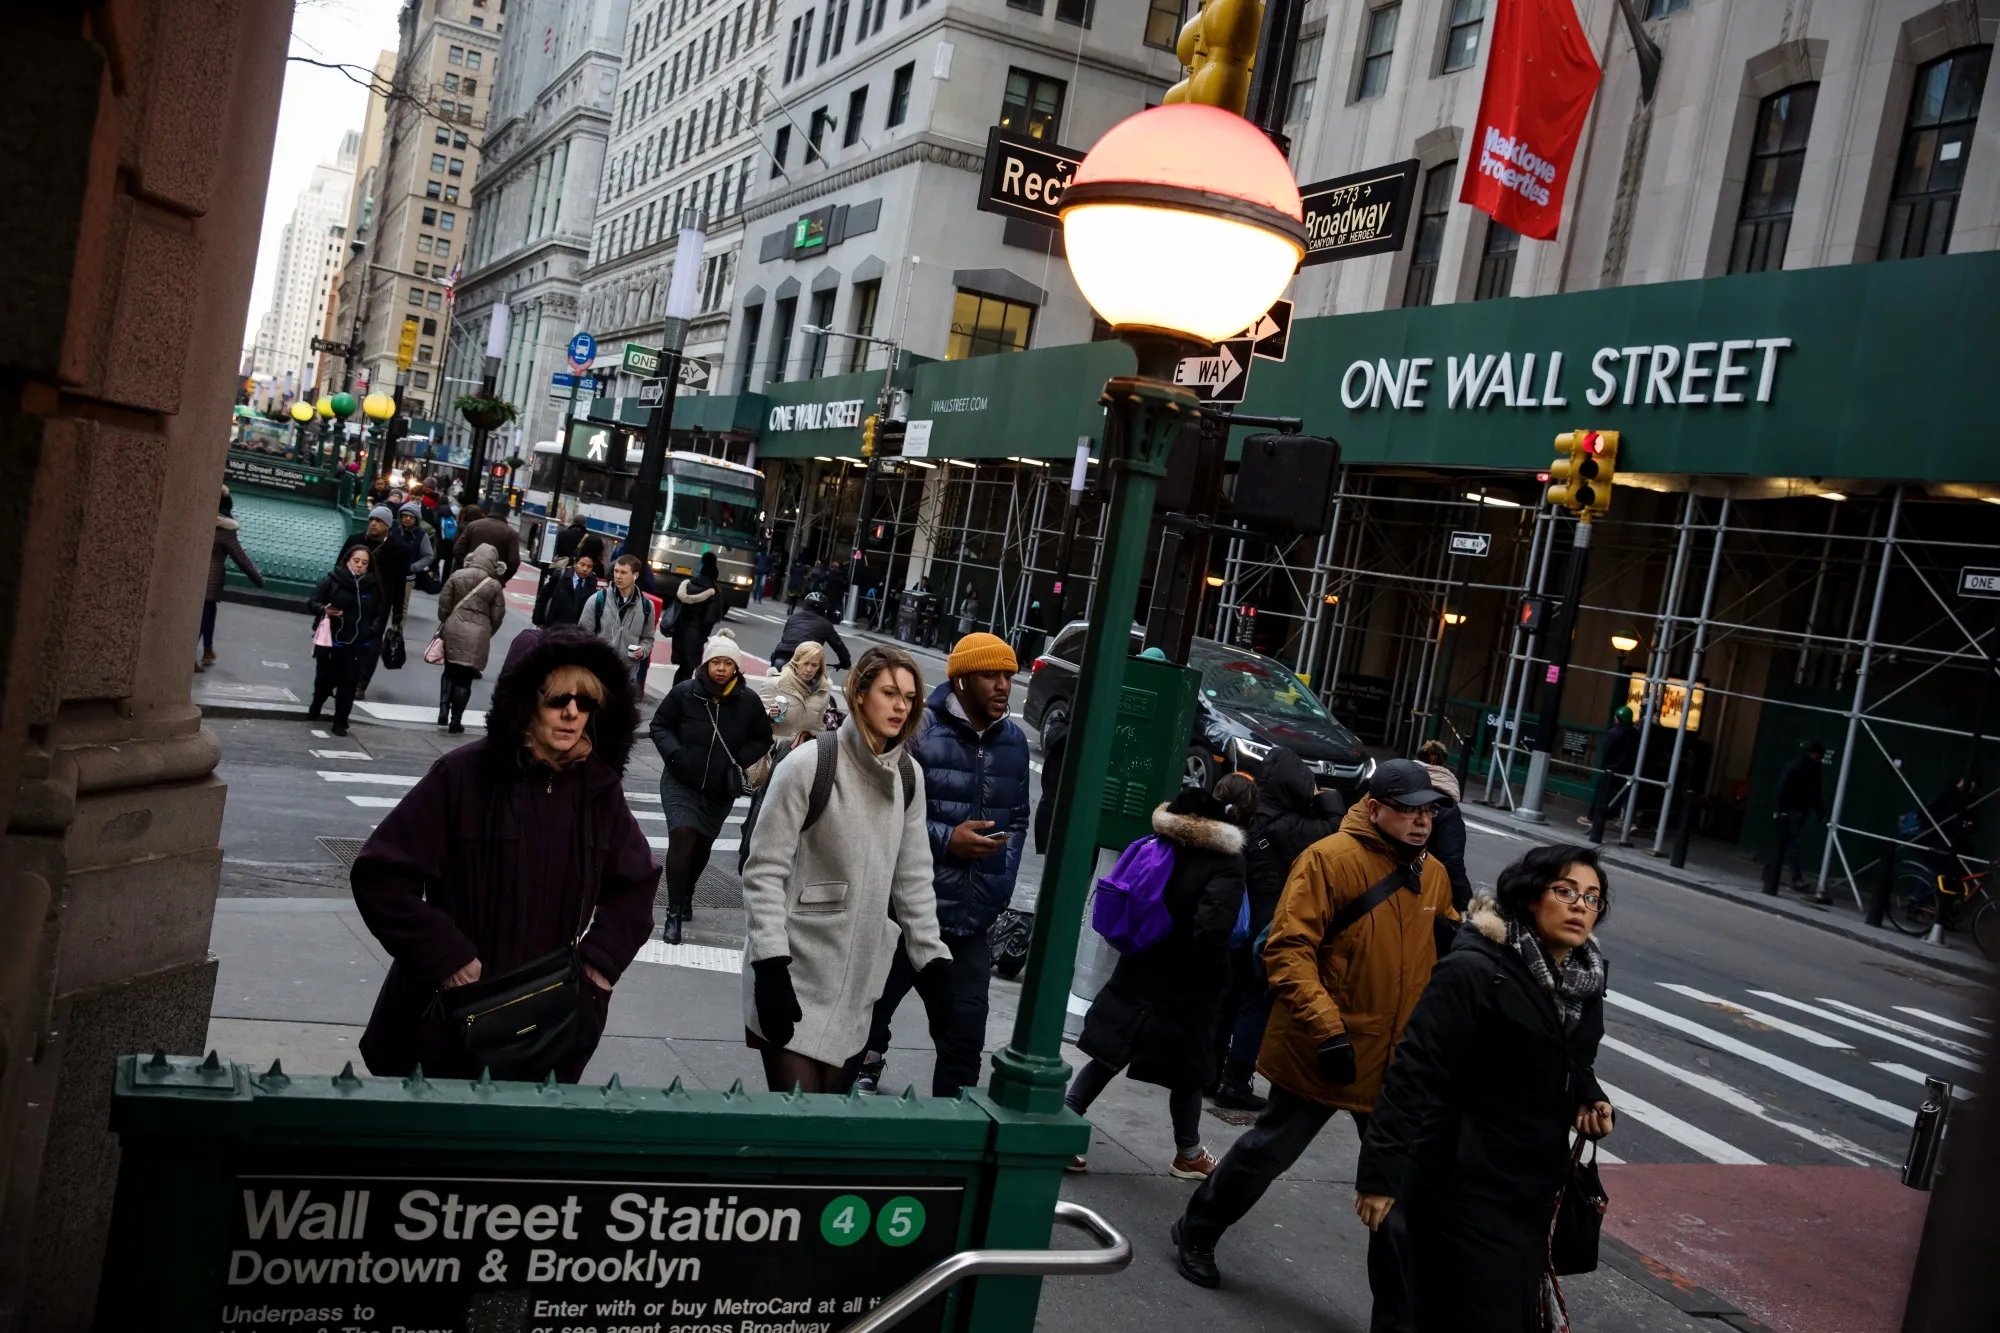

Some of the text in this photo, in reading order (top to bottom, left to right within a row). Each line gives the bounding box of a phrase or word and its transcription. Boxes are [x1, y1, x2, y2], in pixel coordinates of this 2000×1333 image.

[1331, 186, 1360, 207] 57-73
[1305, 201, 1391, 239] Broadway
[1309, 228, 1375, 250] CANYON OF HEROES
[631, 353, 657, 371] ONE
[680, 367, 699, 378] AY
[1198, 360, 1233, 383] WAY
[1341, 338, 1791, 409] ONE WALL STREET
[769, 399, 864, 431] ONE WALL STREET
[931, 396, 988, 414] 1WALLSTREET.COM
[247, 463, 273, 475] Street
[274, 467, 303, 480] Station
[1455, 538, 1467, 548] ONE
[1971, 576, 1995, 589] ONE
[243, 1189, 370, 1241] Wall
[394, 1189, 583, 1241] Street
[605, 1191, 801, 1242] Station
[227, 1248, 701, 1289] Downtown & Brooklyn
[221, 1303, 376, 1326] Underpass to
[533, 1300, 588, 1317] Enter
[596, 1299, 636, 1317] with
[643, 1303, 665, 1317] or
[671, 1299, 708, 1319] buy
[713, 1297, 812, 1316] MetroCard
[818, 1298, 837, 1314] at
[842, 1296, 863, 1313] all
[669, 1324, 733, 1333] across
[739, 1319, 831, 1333] Broadway
